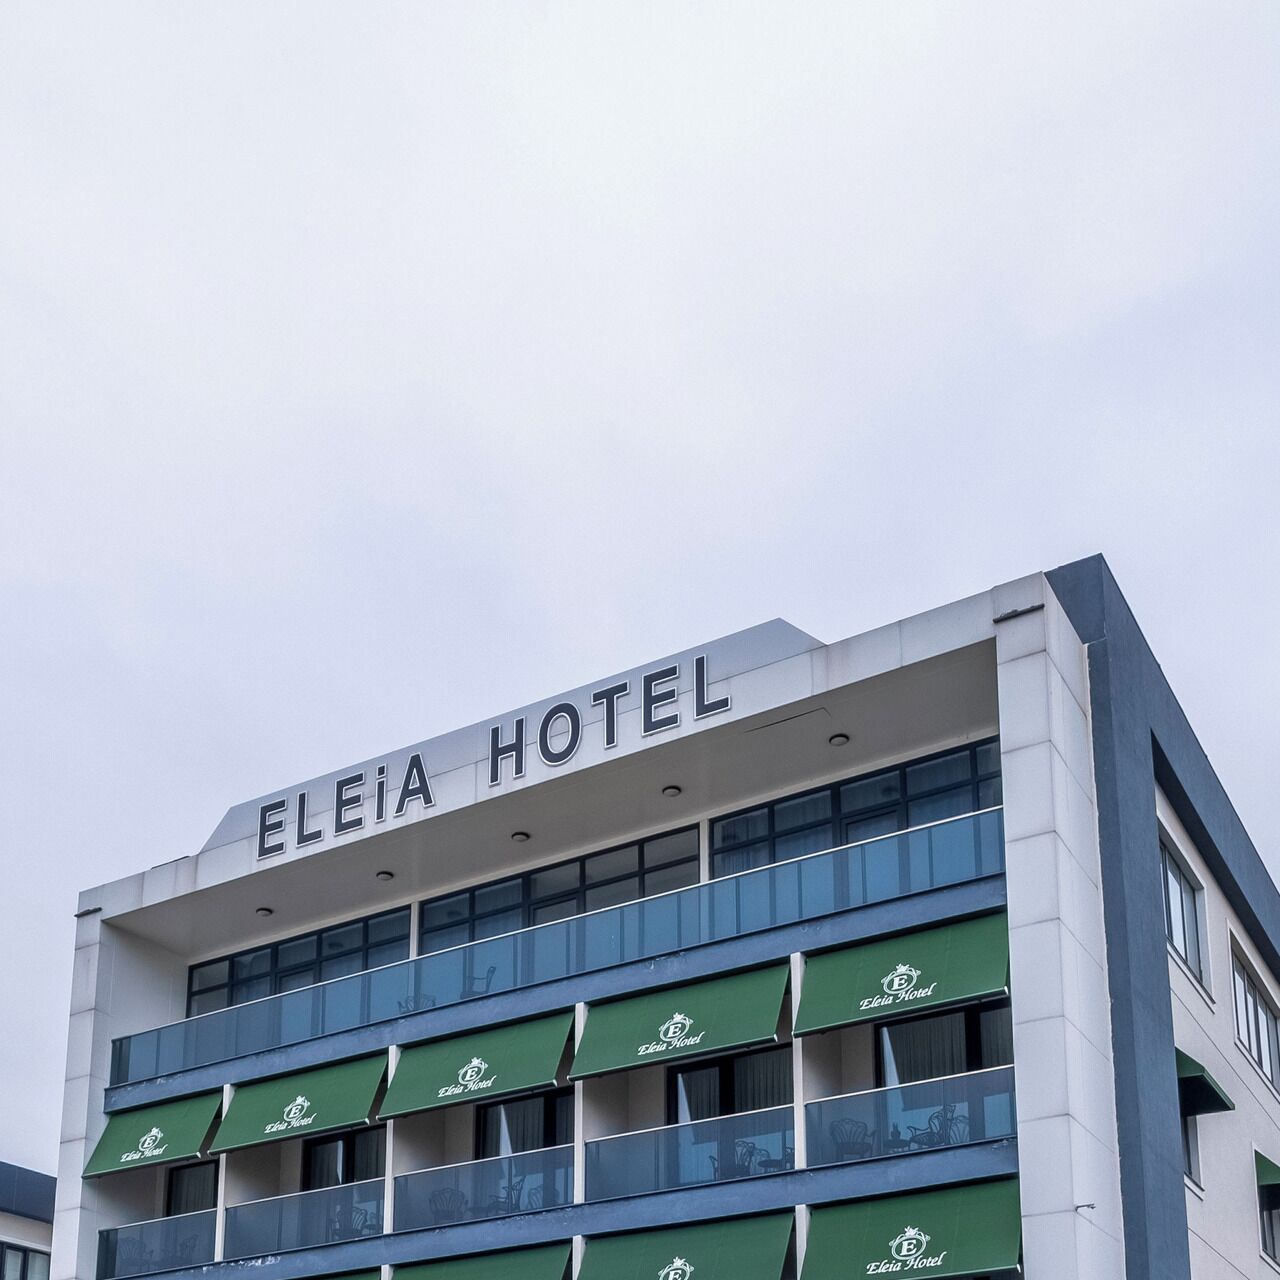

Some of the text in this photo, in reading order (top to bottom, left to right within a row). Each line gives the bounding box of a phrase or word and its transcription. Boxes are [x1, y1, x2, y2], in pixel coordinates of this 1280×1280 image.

[489, 654, 731, 788] HOTEL
[859, 982, 937, 1010] Eleia Hotel
[637, 1031, 705, 1055] Eleia Hotel
[866, 1251, 947, 1274] Eleia Hotel
